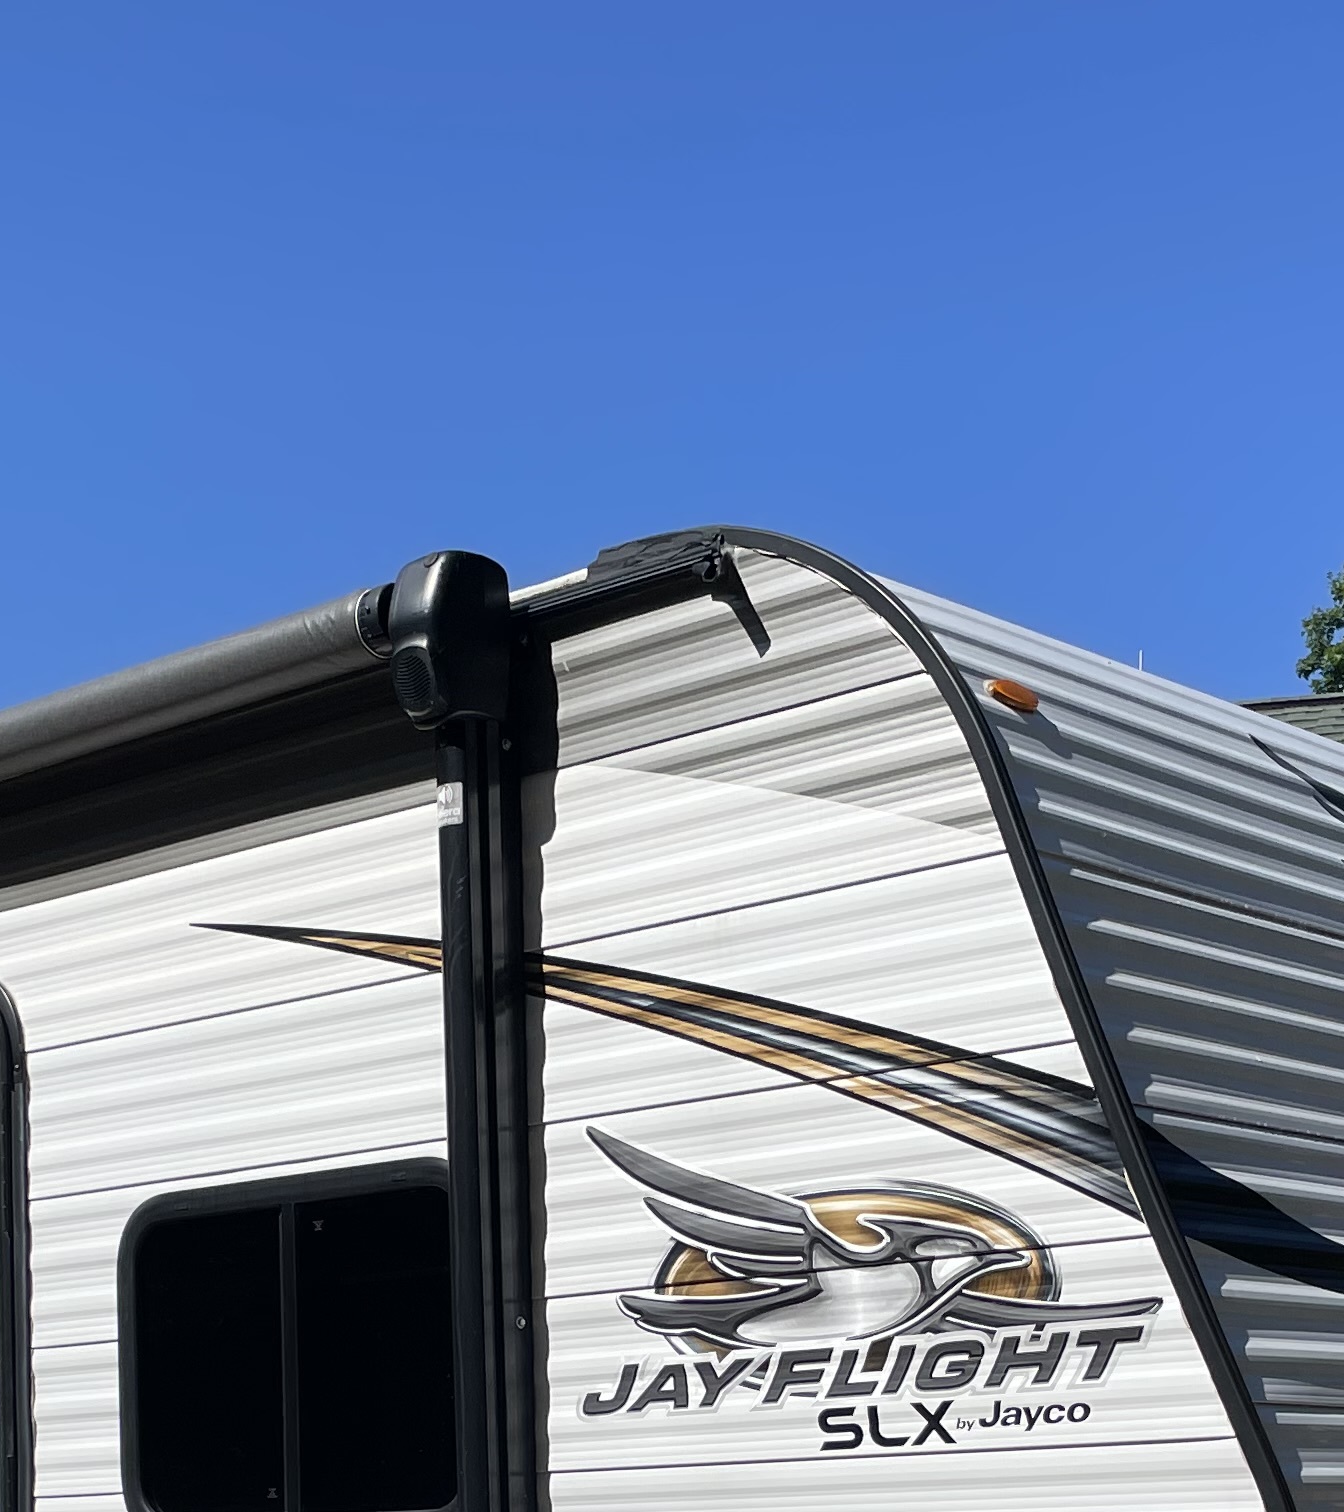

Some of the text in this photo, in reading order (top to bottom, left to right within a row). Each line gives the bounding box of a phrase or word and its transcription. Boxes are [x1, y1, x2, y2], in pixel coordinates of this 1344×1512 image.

[582, 1325, 1144, 1417] JAY FLIGHT
[817, 1400, 1092, 1451] SLX by Jayco
